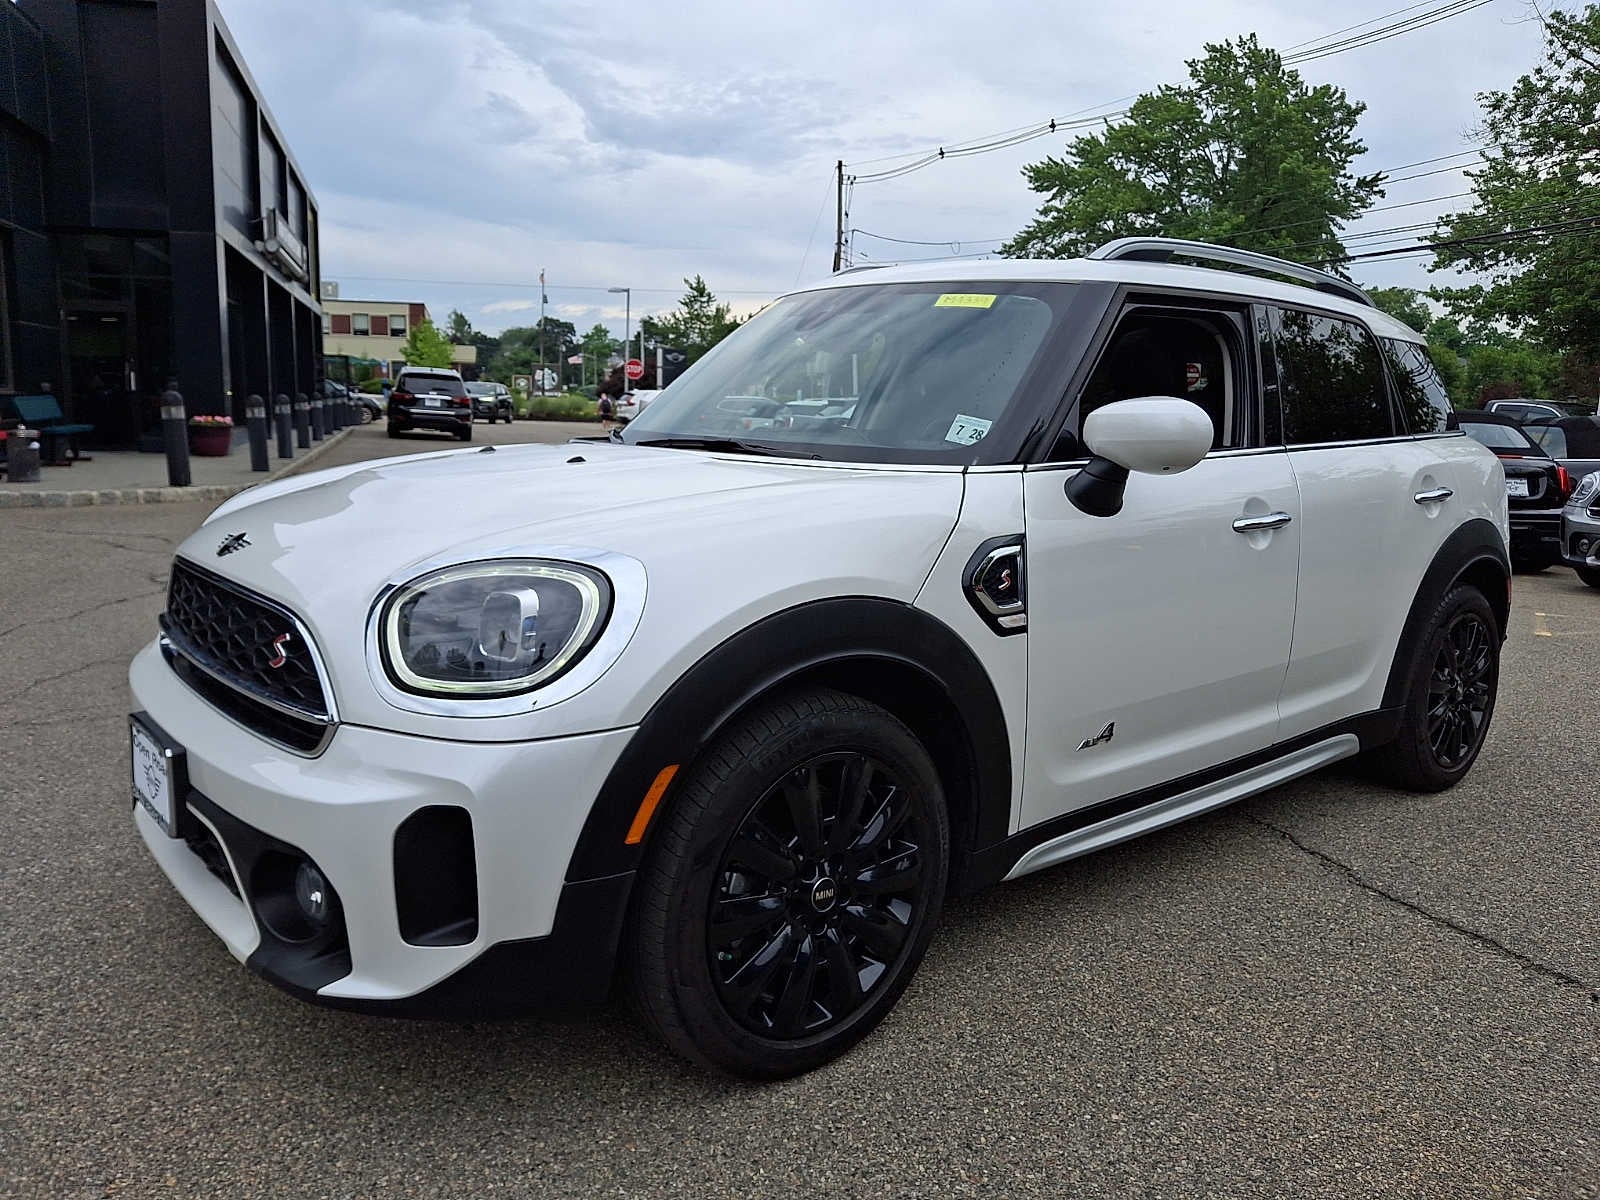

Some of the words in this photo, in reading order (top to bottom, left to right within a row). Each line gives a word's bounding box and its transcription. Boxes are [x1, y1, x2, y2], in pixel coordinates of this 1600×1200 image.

[955, 424, 965, 435] 7
[969, 428, 984, 440] 28
[268, 632, 290, 669] S
[815, 887, 834, 901] MINI
